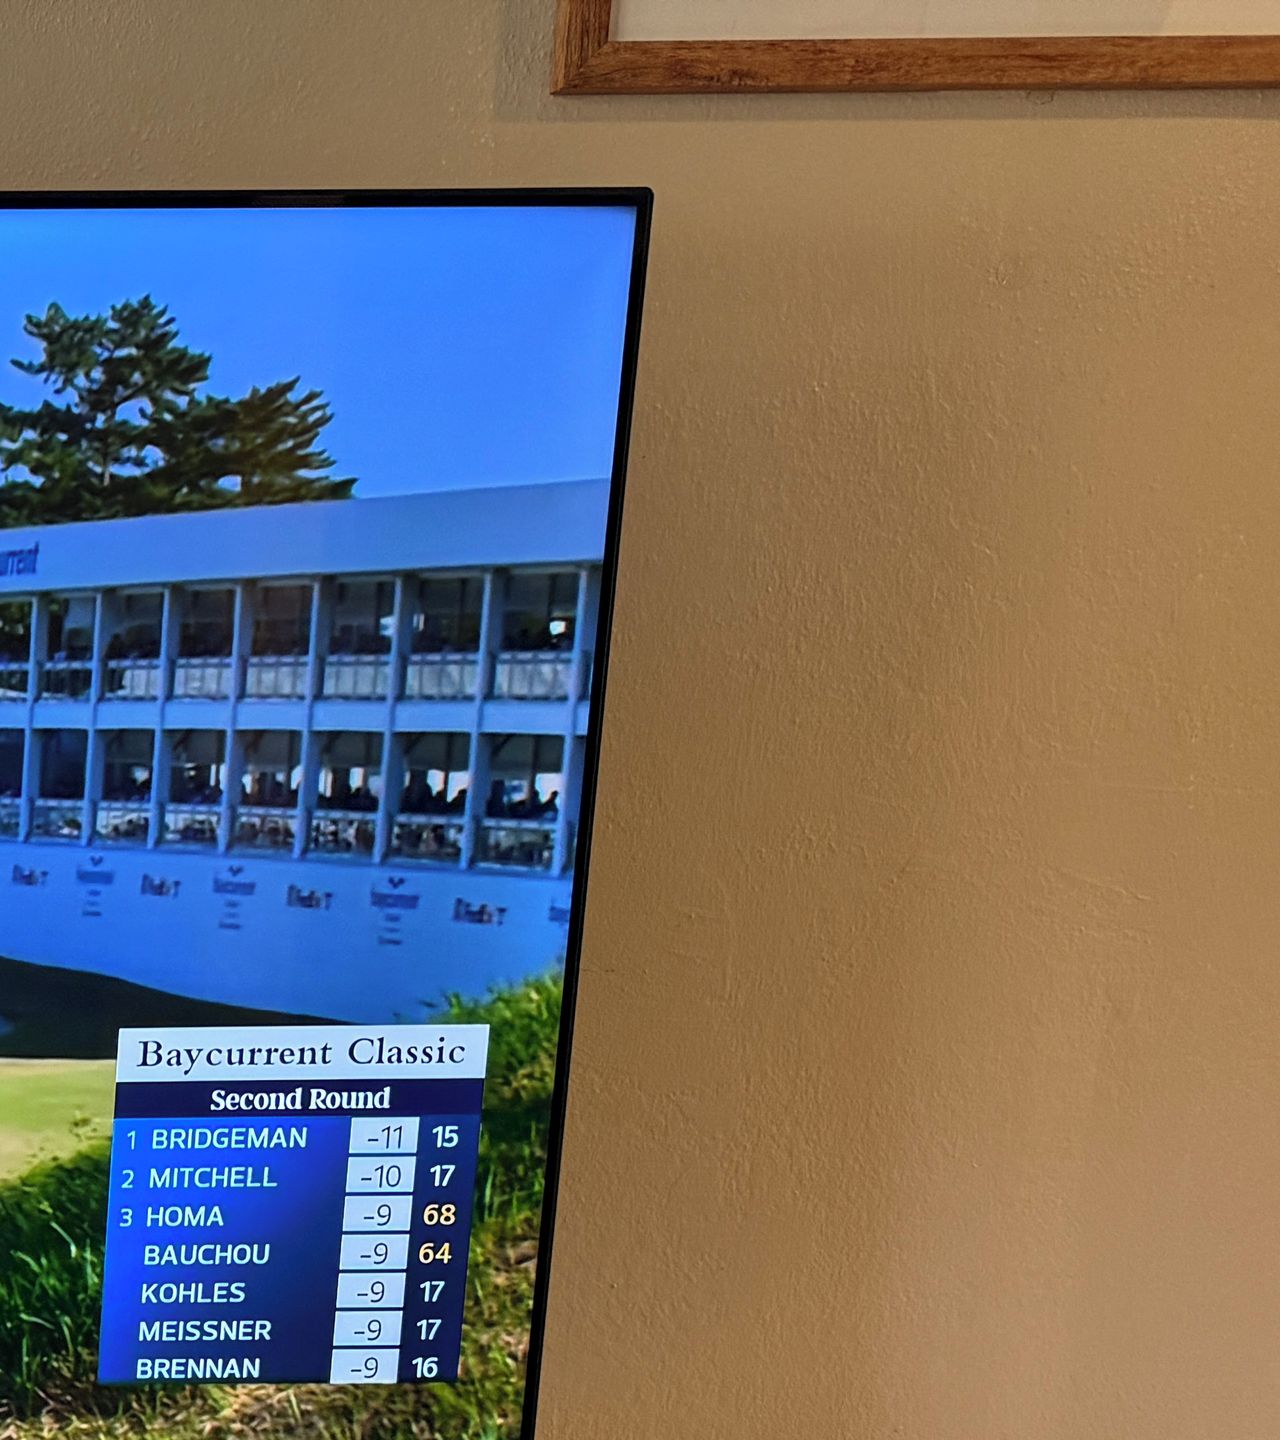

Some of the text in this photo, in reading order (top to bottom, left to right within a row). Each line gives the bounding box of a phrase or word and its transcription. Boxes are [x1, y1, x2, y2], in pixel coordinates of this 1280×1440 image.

[136, 1037, 466, 1075] Baycurrent Classic
[210, 1086, 391, 1111] Second Round
[126, 1125, 459, 1149] 1 BRIDGEMAN -11 15
[121, 1165, 456, 1189] 2 MITCHELL -10 17
[119, 1204, 456, 1227] 3 HOMA -9 68
[143, 1242, 452, 1265] BAUCHOU -9 64
[141, 1281, 445, 1303] KOHLES -9 17
[138, 1319, 442, 1341] MEISSNER -9 17
[136, 1357, 438, 1379] BRENNAN -9 16
